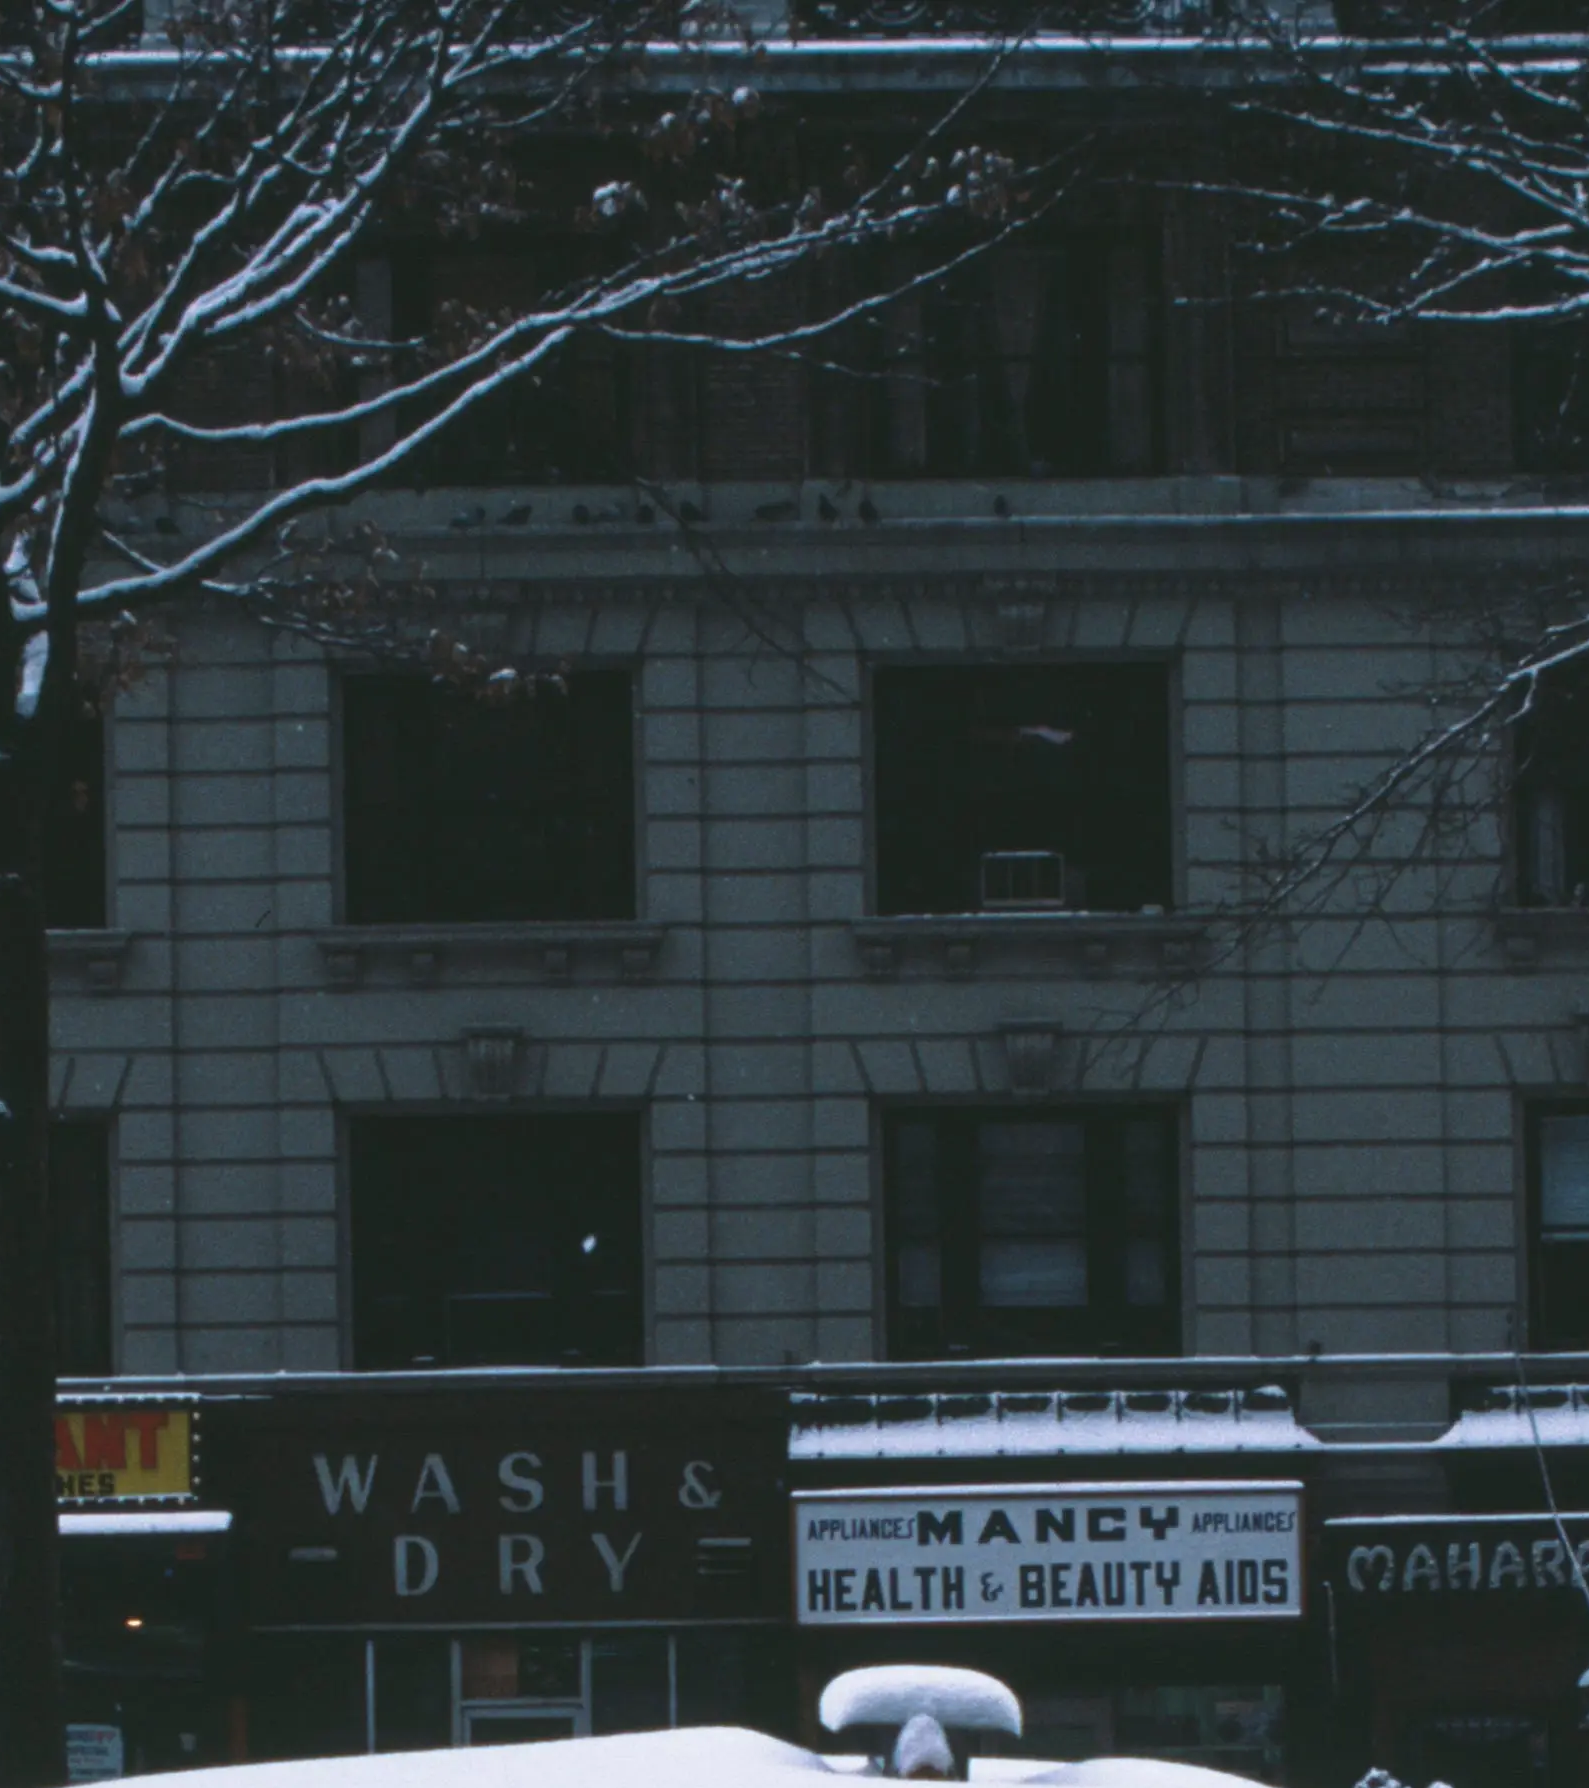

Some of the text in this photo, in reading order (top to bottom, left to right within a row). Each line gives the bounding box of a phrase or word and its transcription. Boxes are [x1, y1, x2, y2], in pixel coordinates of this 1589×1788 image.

[313, 1451, 722, 1515] WASH &
[808, 1517, 915, 1541] APPLIANCES
[1192, 1511, 1296, 1534] APPLIANCES
[394, 1532, 643, 1597] DRY
[809, 1559, 1288, 1612] HEALTH & BEAUTY AIDS
